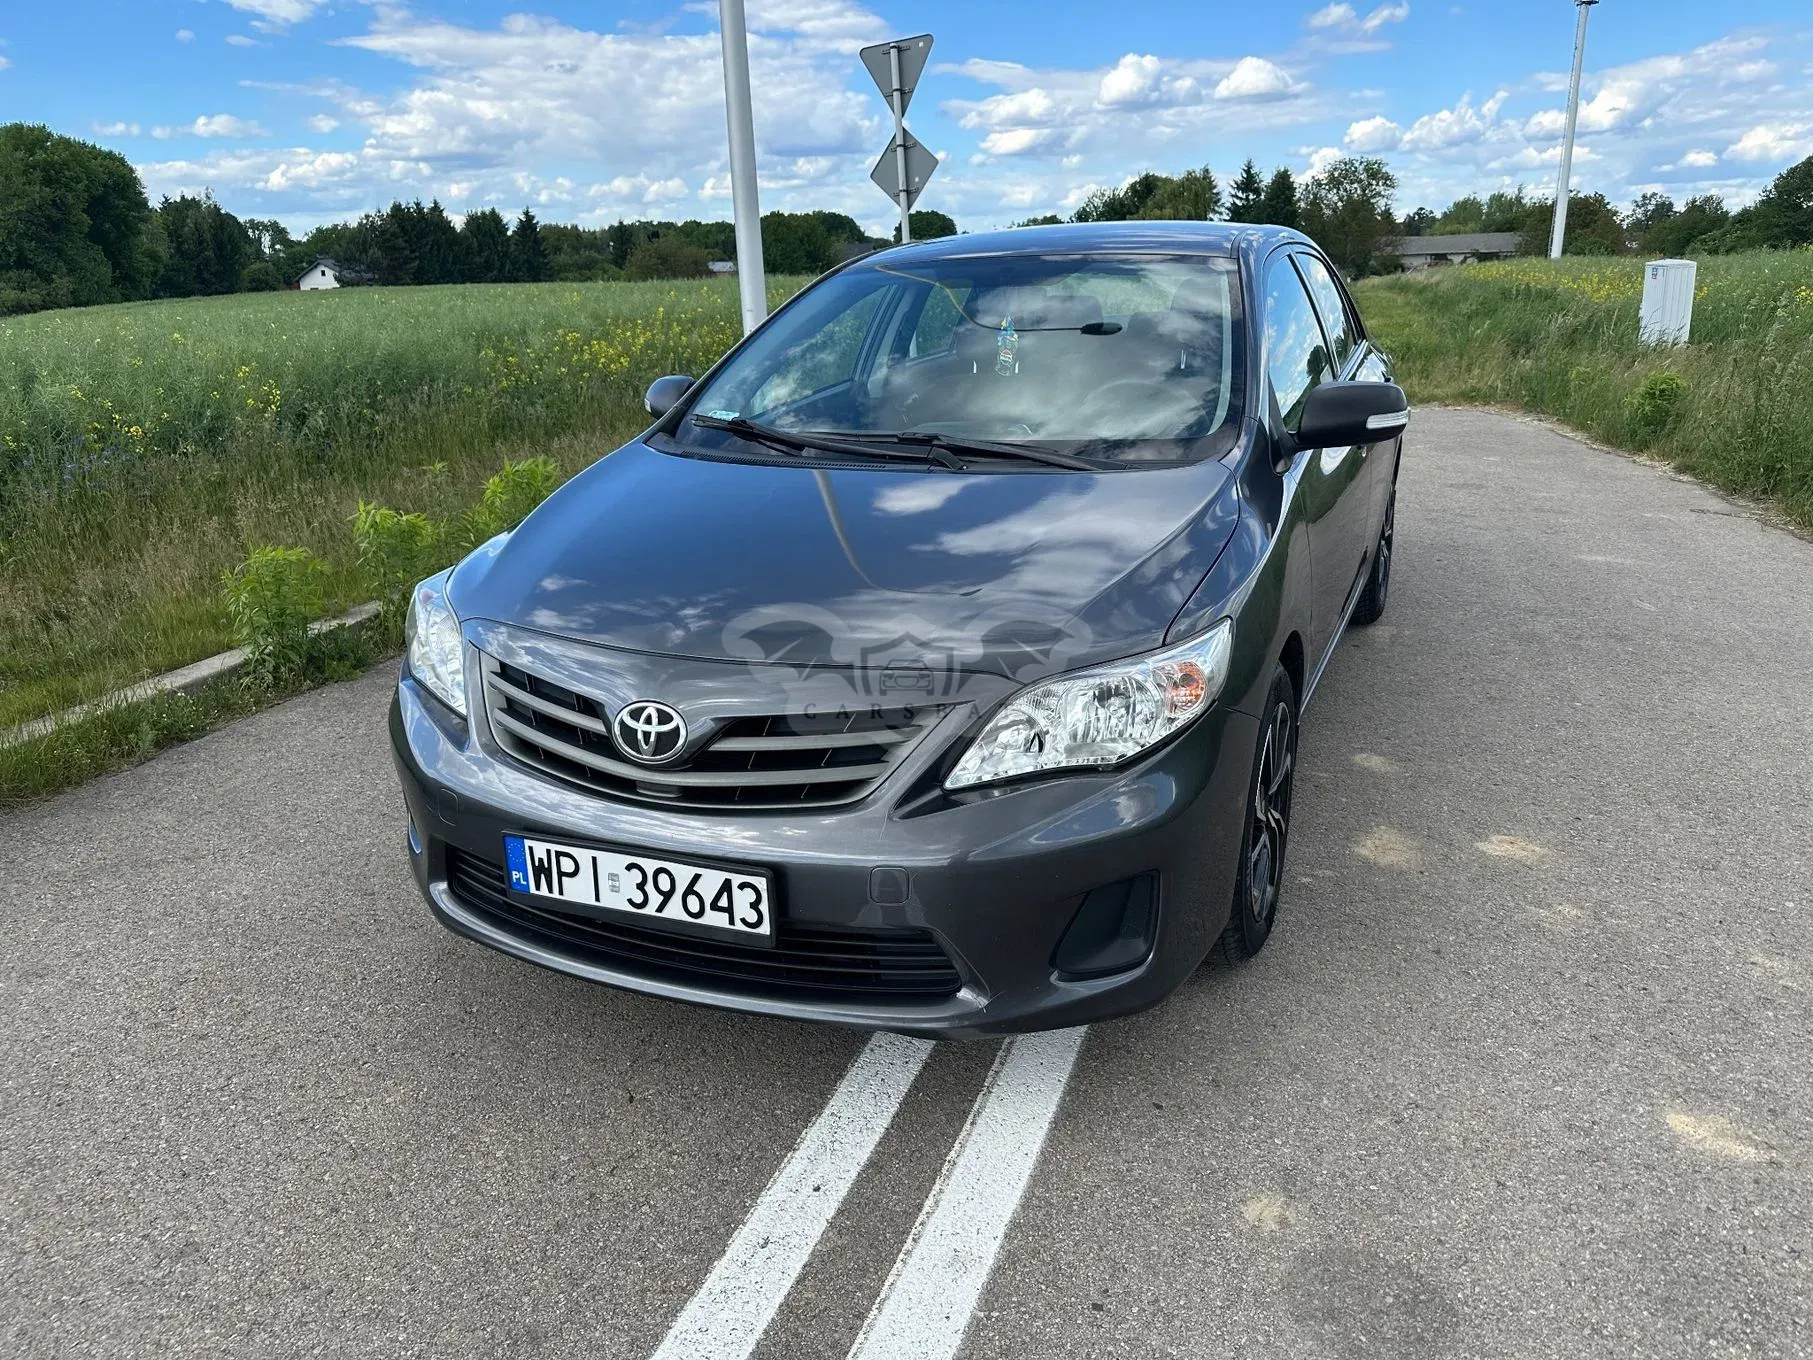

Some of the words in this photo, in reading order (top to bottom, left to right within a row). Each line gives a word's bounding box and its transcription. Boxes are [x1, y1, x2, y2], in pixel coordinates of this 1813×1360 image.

[511, 870, 527, 885] PL
[527, 845, 601, 903] WPI
[624, 862, 764, 930] 39643
